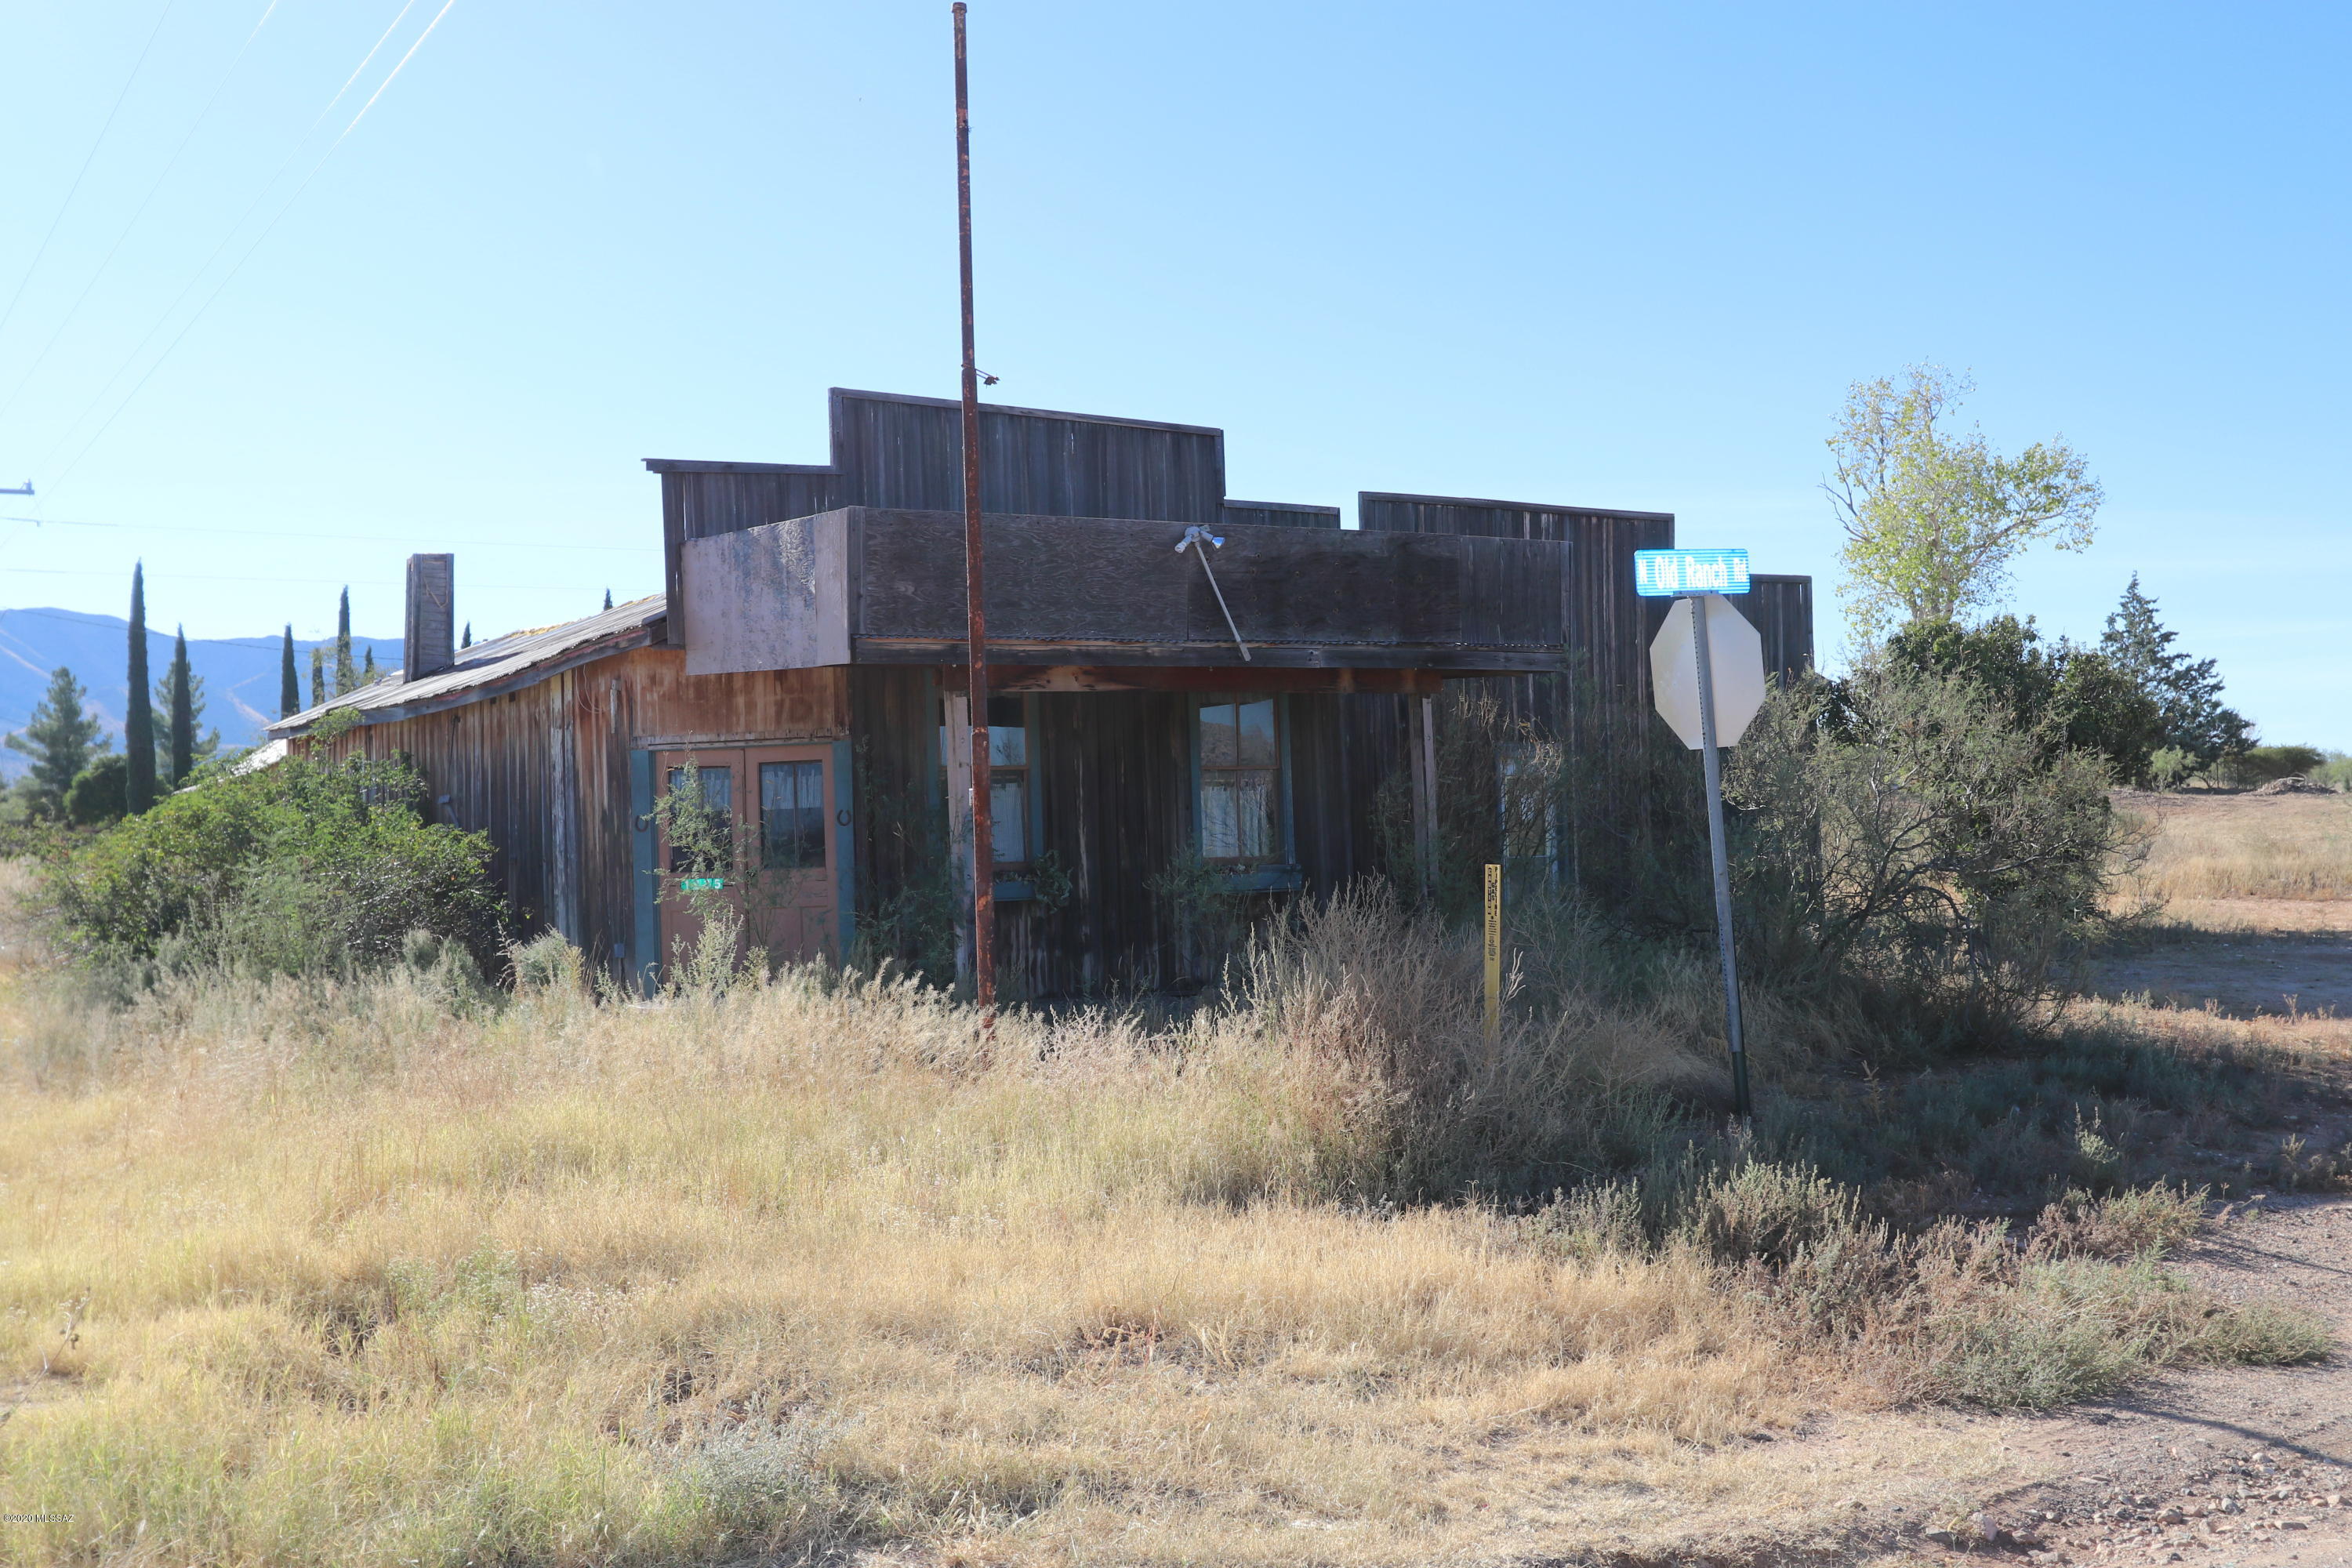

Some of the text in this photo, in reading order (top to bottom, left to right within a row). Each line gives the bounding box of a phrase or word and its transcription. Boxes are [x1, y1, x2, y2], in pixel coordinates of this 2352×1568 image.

[1638, 559, 1648, 584] N
[1655, 557, 1679, 589] Old
[1686, 556, 1728, 587] Ranch
